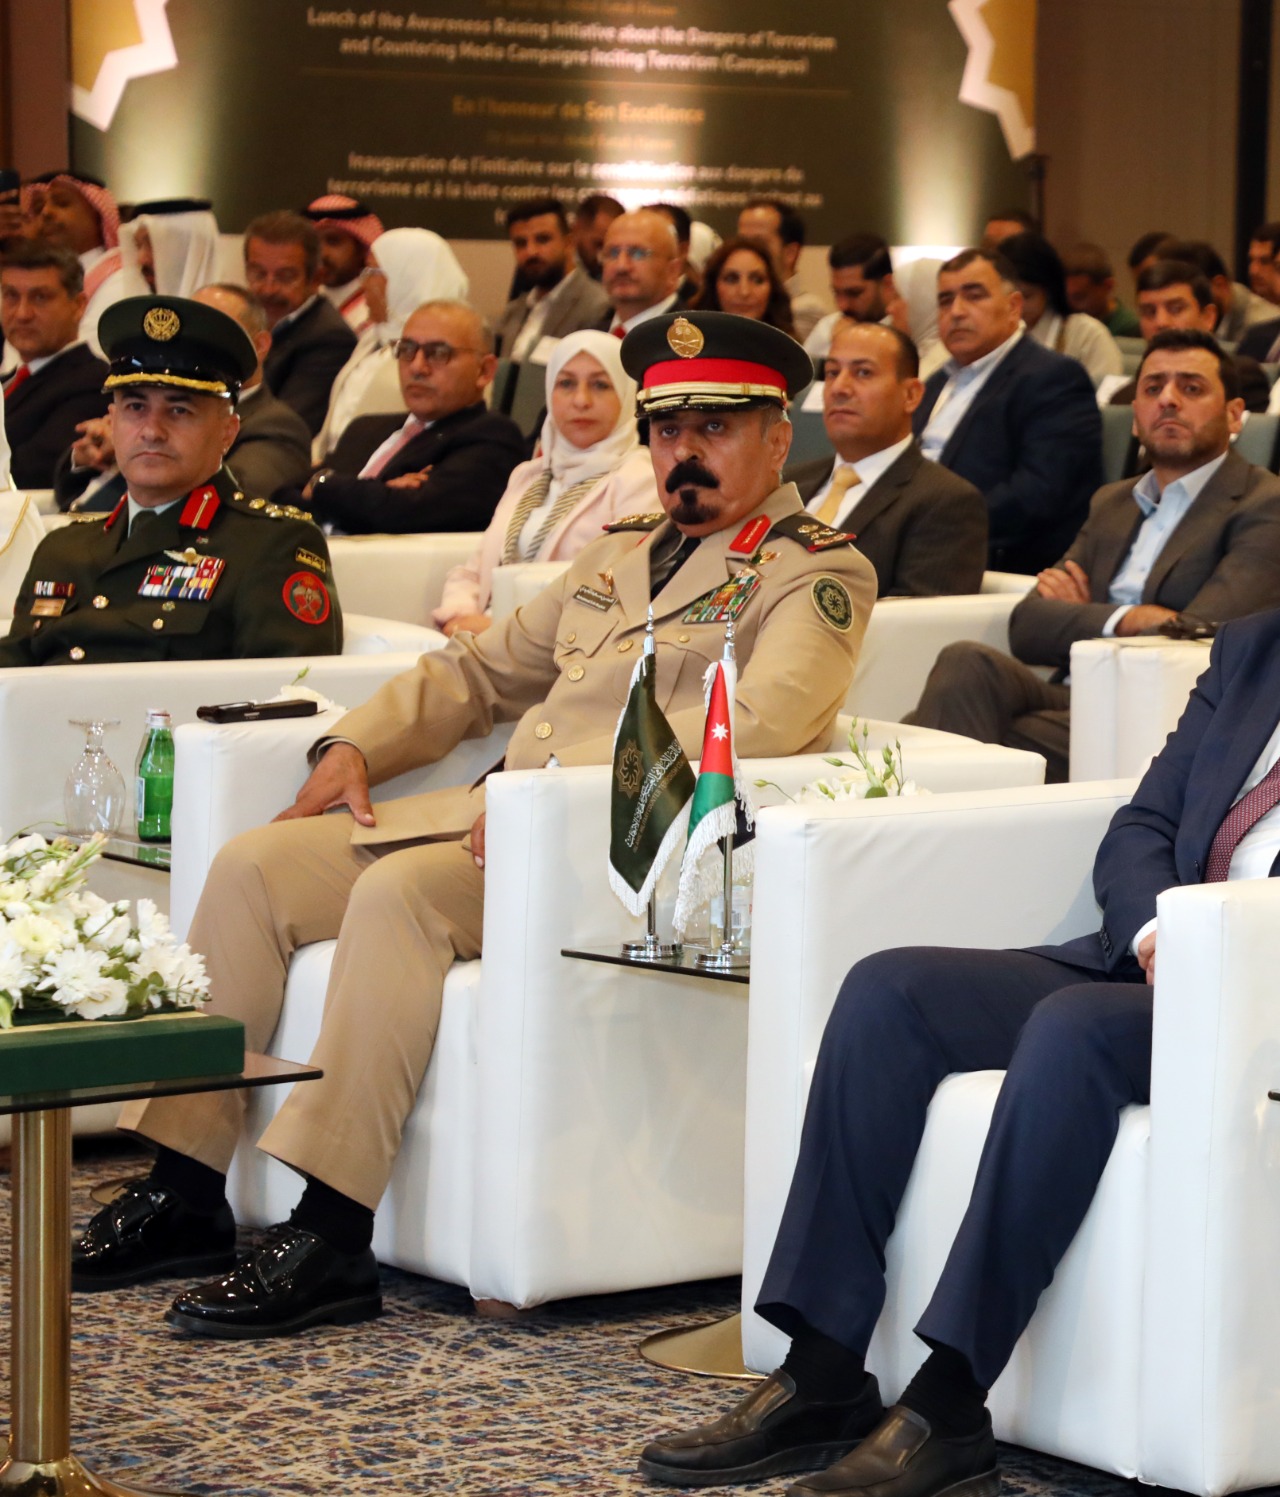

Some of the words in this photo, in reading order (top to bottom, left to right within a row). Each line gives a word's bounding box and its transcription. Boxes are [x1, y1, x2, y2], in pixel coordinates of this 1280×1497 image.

[358, 10, 376, 28] of
[378, 10, 404, 30] the
[406, 13, 491, 35] Awareness
[493, 17, 550, 42] Raising
[617, 23, 660, 43] about
[661, 25, 685, 43] the
[767, 31, 838, 52] Terrorism
[339, 37, 370, 55] and
[372, 36, 458, 63] Countering
[459, 41, 505, 61] Media
[507, 44, 589, 69] Campaigns
[648, 50, 720, 71] Terrorism
[560, 101, 581, 119] de
[584, 100, 616, 121] Son
[617, 101, 704, 123] Excellence
[448, 156, 468, 174] de
